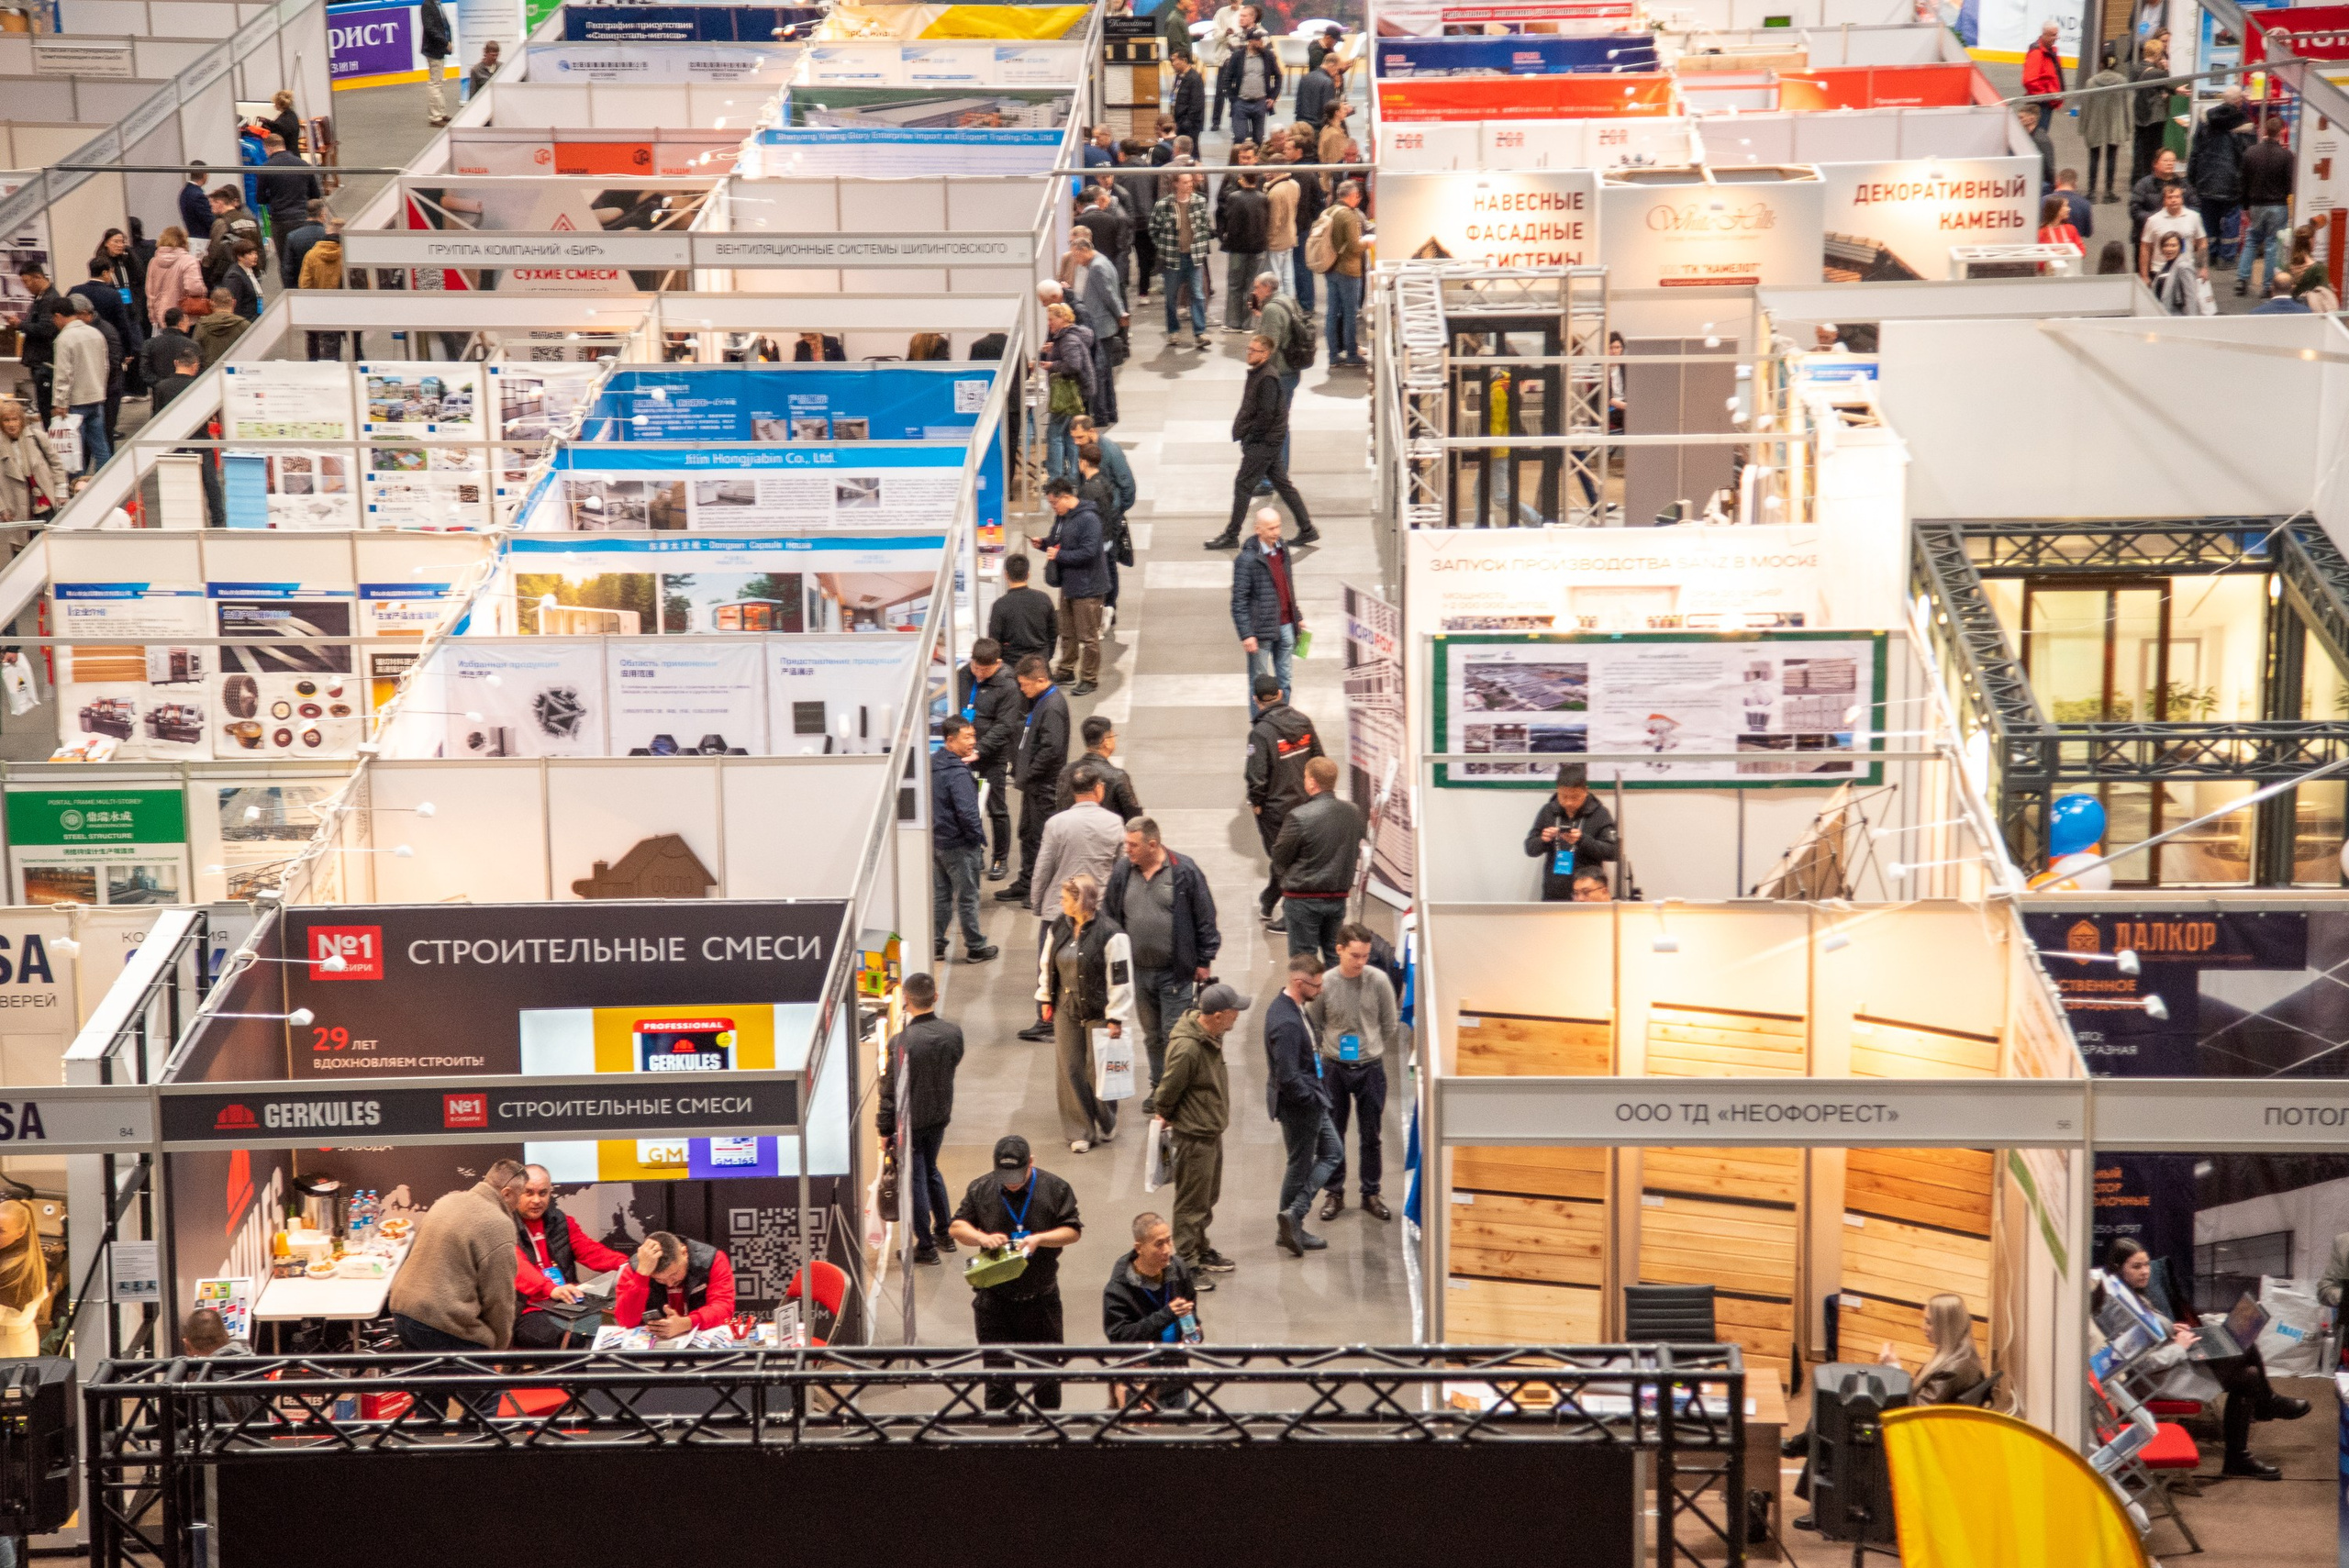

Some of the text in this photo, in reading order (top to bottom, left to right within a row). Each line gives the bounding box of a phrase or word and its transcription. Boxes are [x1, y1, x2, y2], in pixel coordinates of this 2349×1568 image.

[1854, 174, 2025, 206] ДЕКОРАТИВНЫЙ
[1474, 192, 1585, 211] НАВЕСНЫЕ
[1940, 210, 2025, 230] КАМЕНЬ
[1467, 222, 1584, 243] ФАСАДНЫЕ
[428, 242, 606, 257] ГРУППА КОМПАНИЙ «БИР»
[716, 242, 1008, 257] ВЕНТИЛЯЦИОННЫЕ СИСТЕМЫ ШИЛИНГОВСКОГО
[1485, 251, 1583, 267] СИСТЕМЫ
[513, 268, 619, 281] СУХИЕ СМЕСИ
[685, 453, 710, 465] Jilin
[1430, 559, 1508, 572] ЗАПУСК
[1512, 557, 1672, 572] ПРОИЗВОДСТВА
[619, 659, 658, 667] Область
[407, 936, 822, 964] СТРОИТЕЛЬНЫЕ СМЕСИ
[643, 1021, 724, 1030] PROFESSIONAL
[312, 1027, 379, 1051] 29 ЛЕТ
[313, 1055, 484, 1070] ВДОХНОВЛЯЕМ СТРОИТЬ!
[648, 1053, 722, 1072] GERKULES
[263, 1101, 382, 1129] GERKULES
[449, 1100, 482, 1115] №1
[498, 1096, 752, 1118] СТРОИТЕЛЬНЫЕ СМЕСИ
[1615, 1104, 1900, 1126] ООО ТД «НЕОФОРЕСТ»
[119, 1128, 134, 1137] 84
